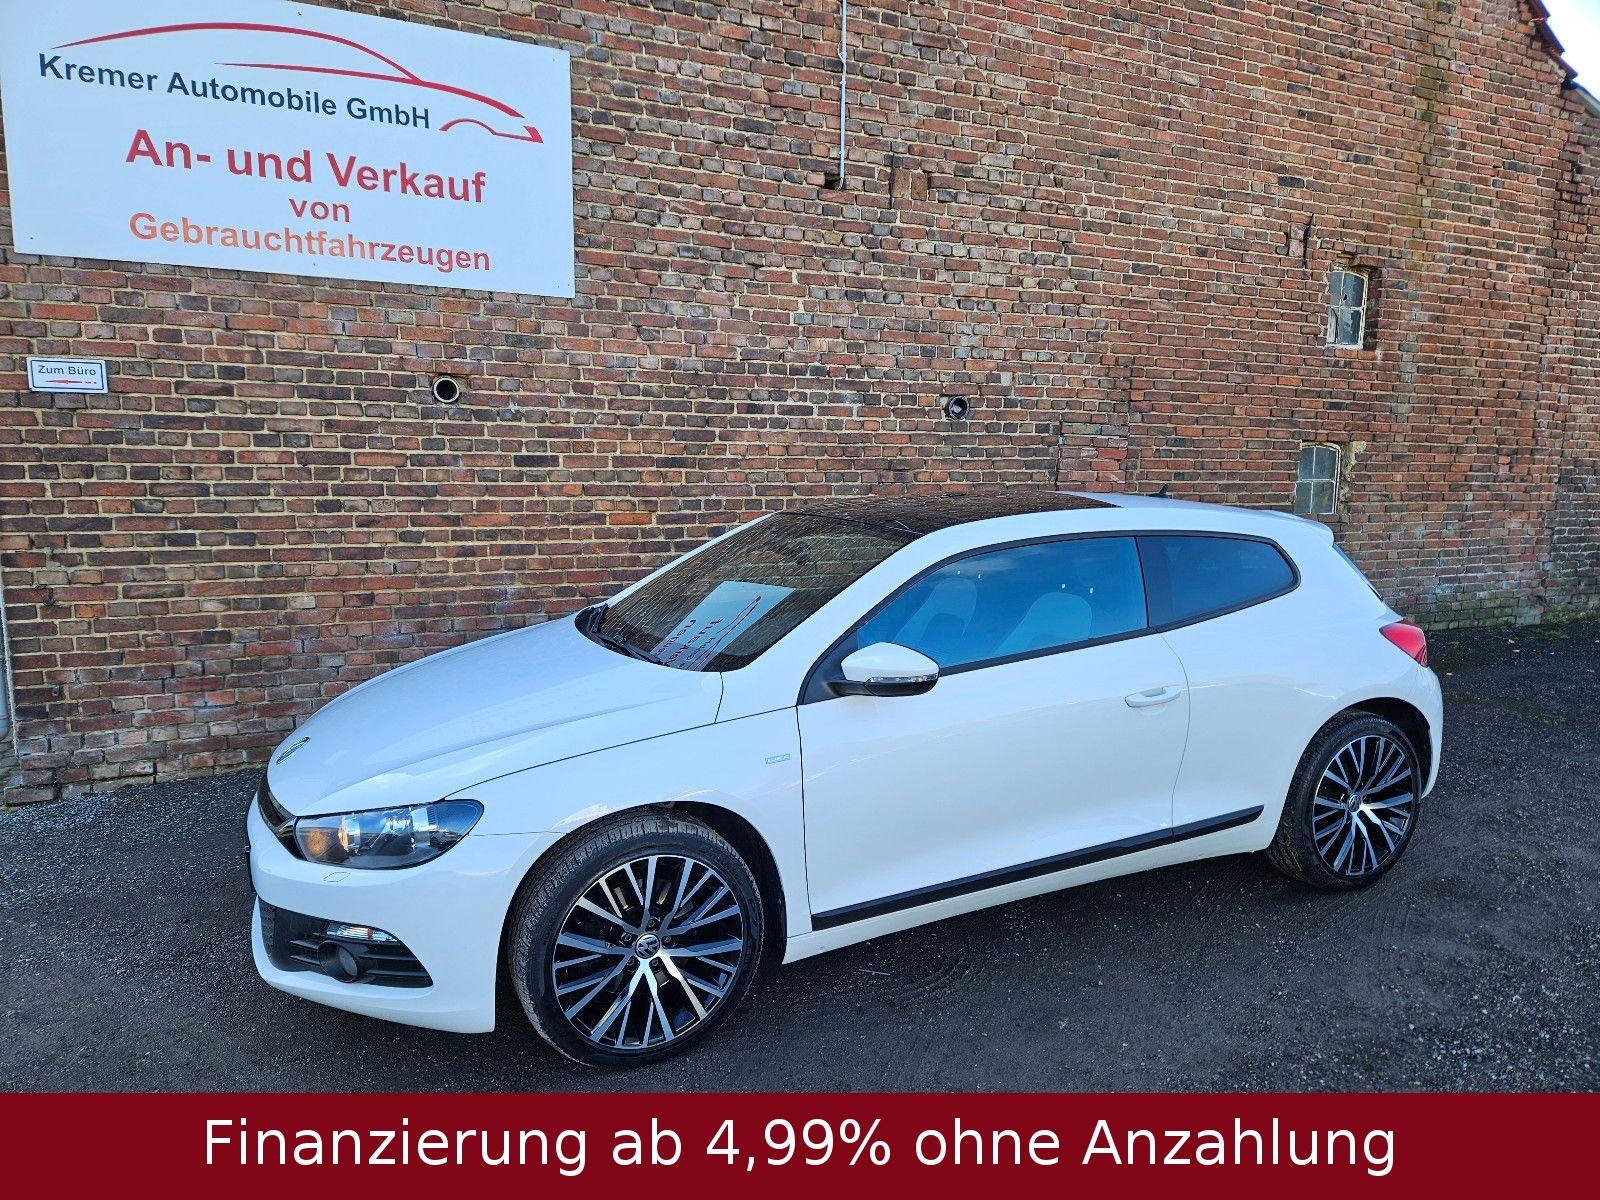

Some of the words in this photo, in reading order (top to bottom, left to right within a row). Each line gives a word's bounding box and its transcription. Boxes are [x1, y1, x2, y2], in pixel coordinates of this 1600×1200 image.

[38, 52, 159, 92] Kremer
[166, 71, 337, 117] Automobile
[346, 98, 430, 130] GmbH
[125, 128, 212, 168] An-
[226, 148, 313, 184] und
[325, 152, 487, 204] Verkauf
[288, 198, 350, 223] von
[129, 212, 491, 274] Gebrauchtfahrzeugen
[38, 364, 64, 375] Zum
[68, 366, 97, 376] Büro
